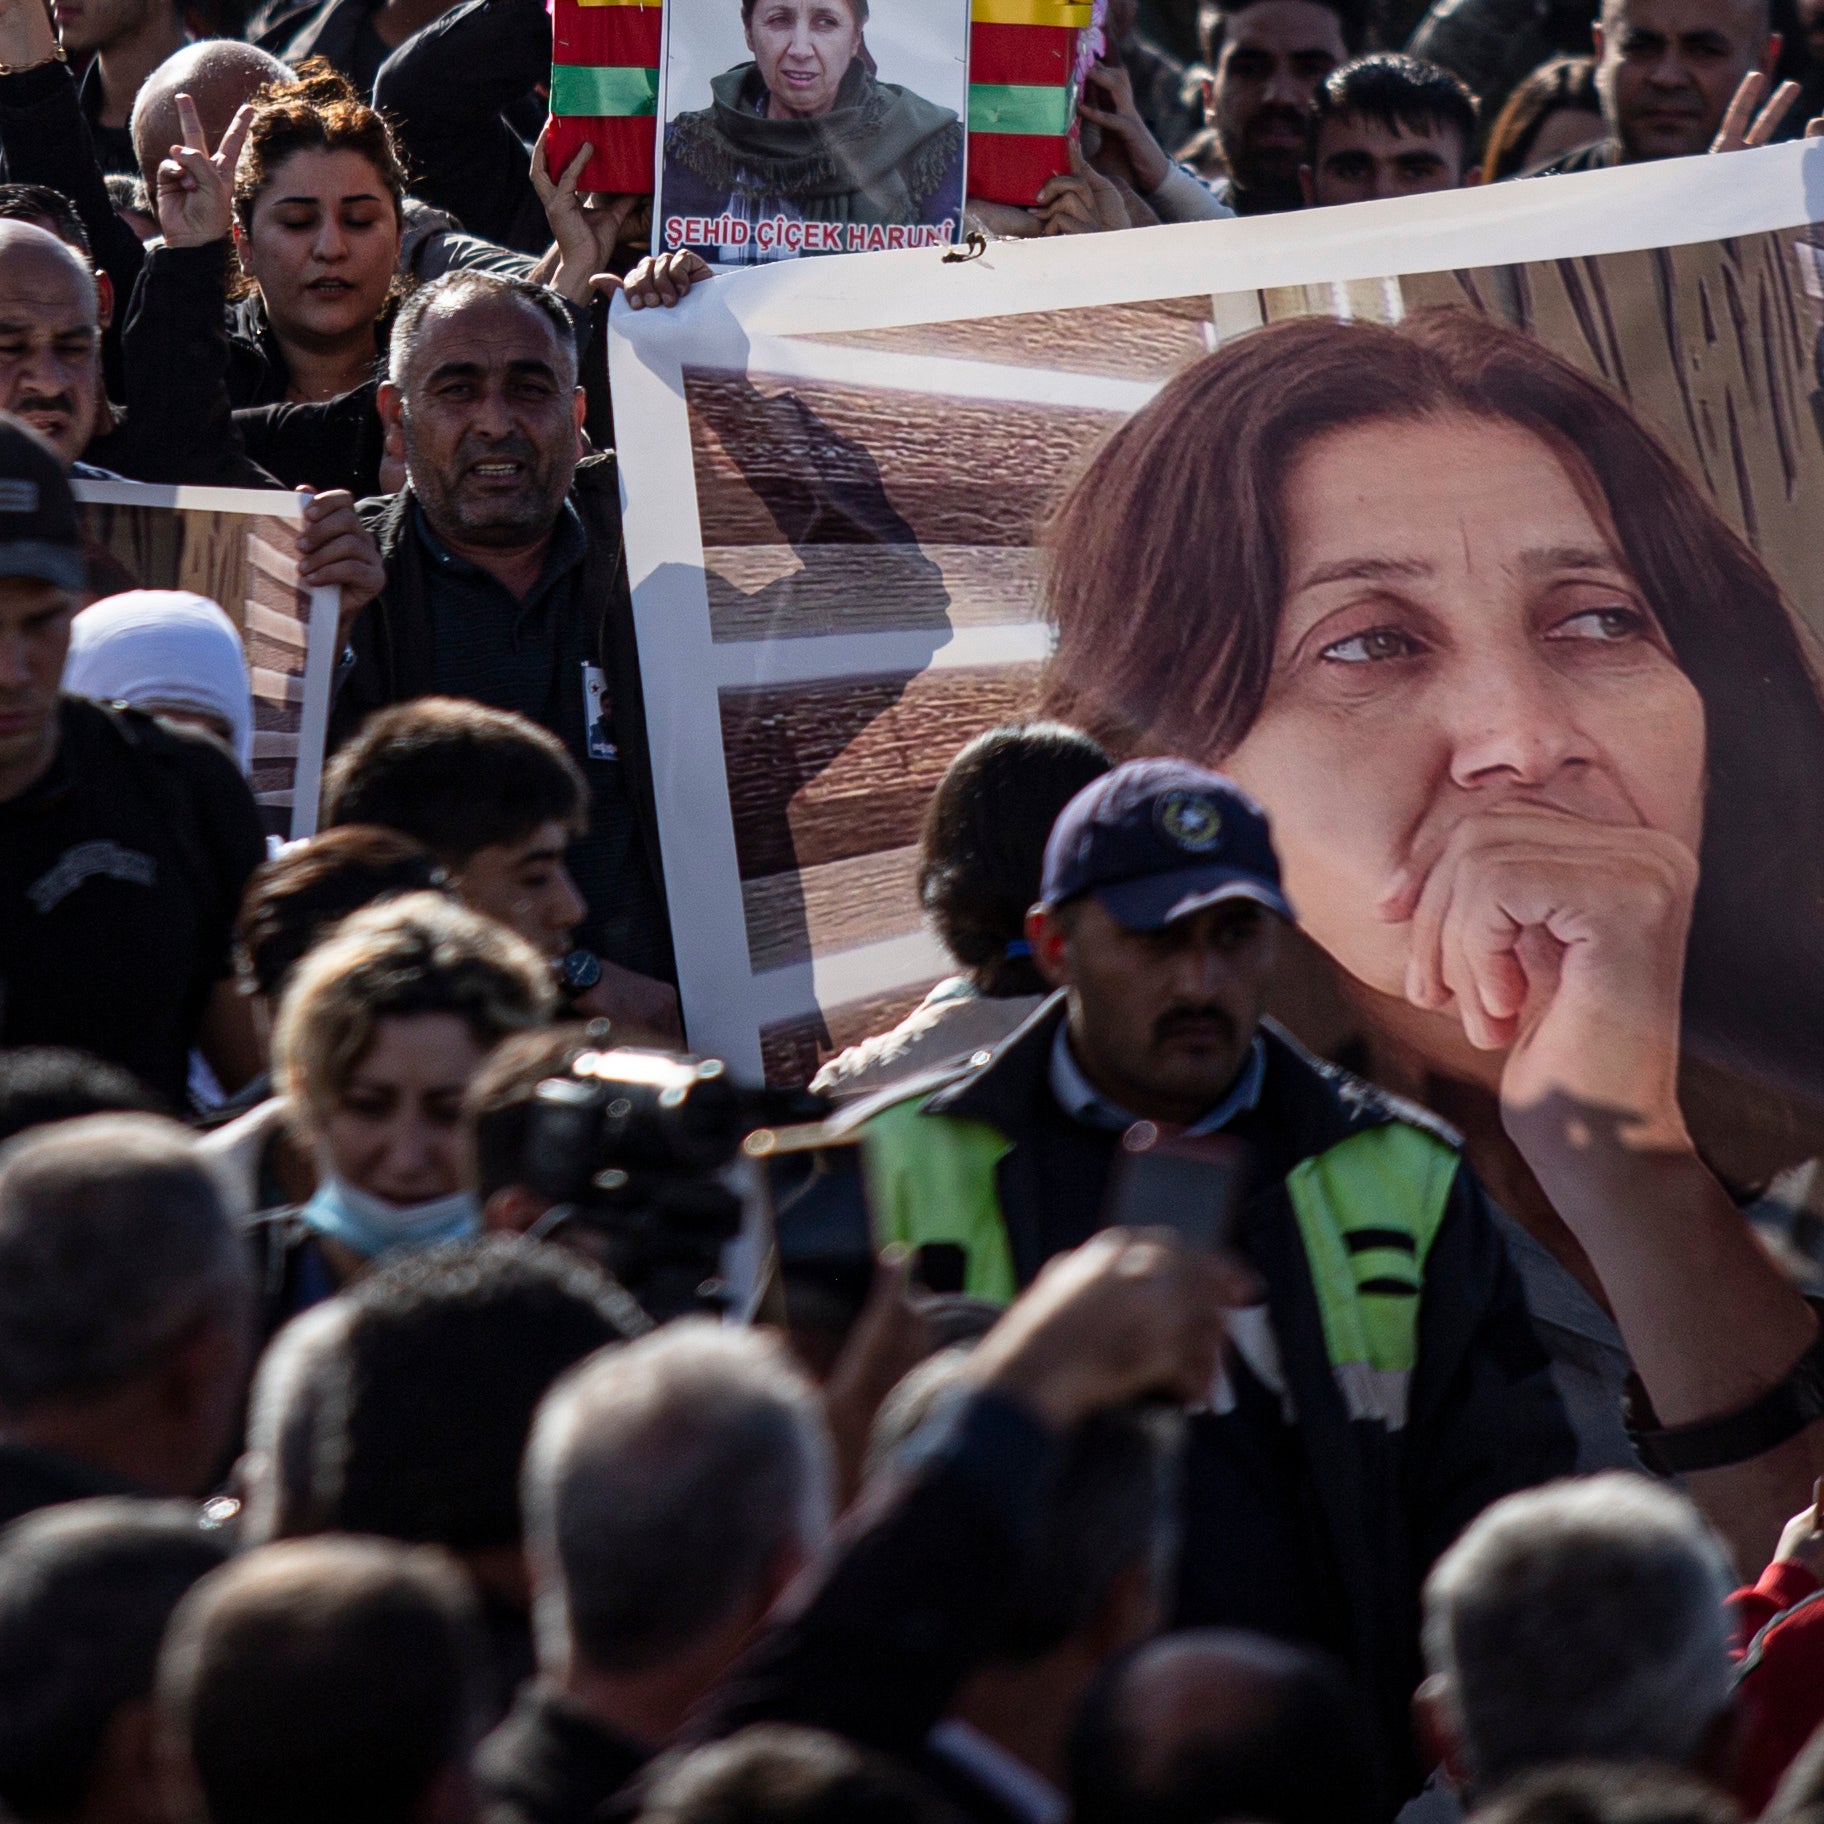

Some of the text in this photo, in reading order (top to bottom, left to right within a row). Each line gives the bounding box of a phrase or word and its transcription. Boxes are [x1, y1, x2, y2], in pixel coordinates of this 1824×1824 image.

[666, 212, 955, 253] ŞEHÎD ÇÎÇEK HARUNÎ
